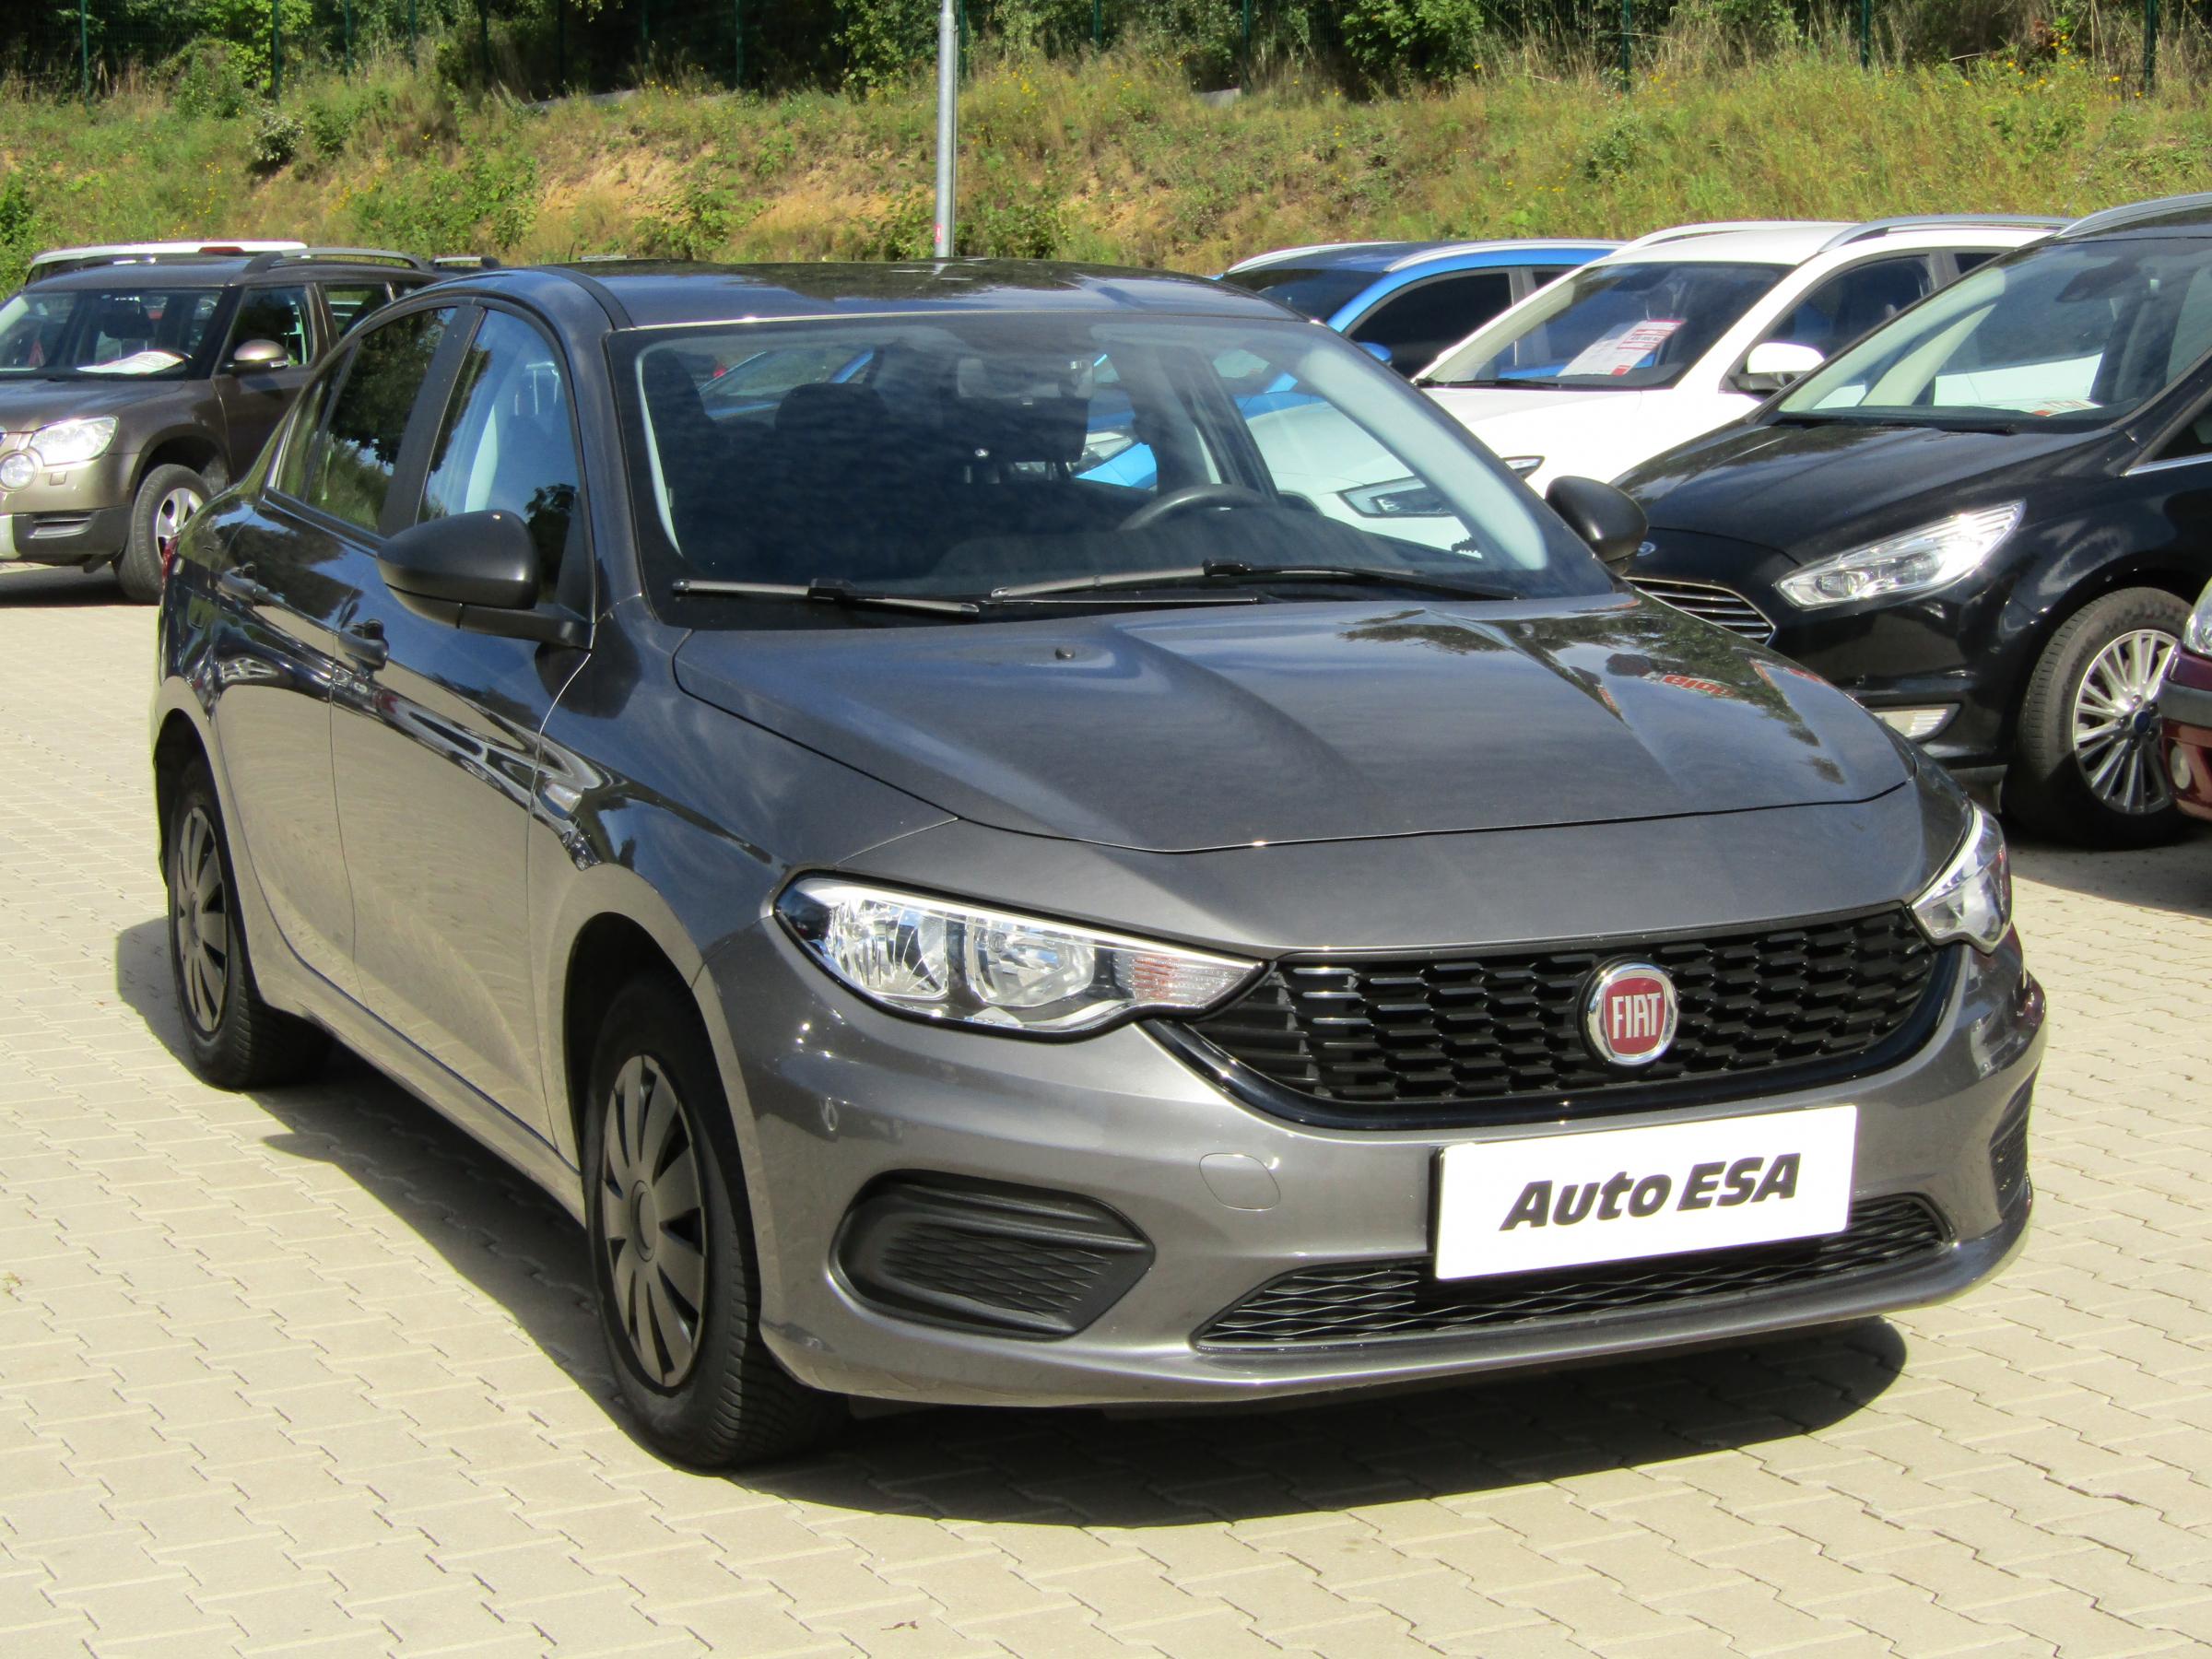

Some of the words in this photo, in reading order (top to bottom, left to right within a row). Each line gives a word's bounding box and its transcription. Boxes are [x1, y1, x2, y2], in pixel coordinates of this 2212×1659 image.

[1612, 993, 1661, 1040] FIAT
[1499, 1172, 1672, 1231] Auto
[1677, 1153, 1801, 1211] ESA
